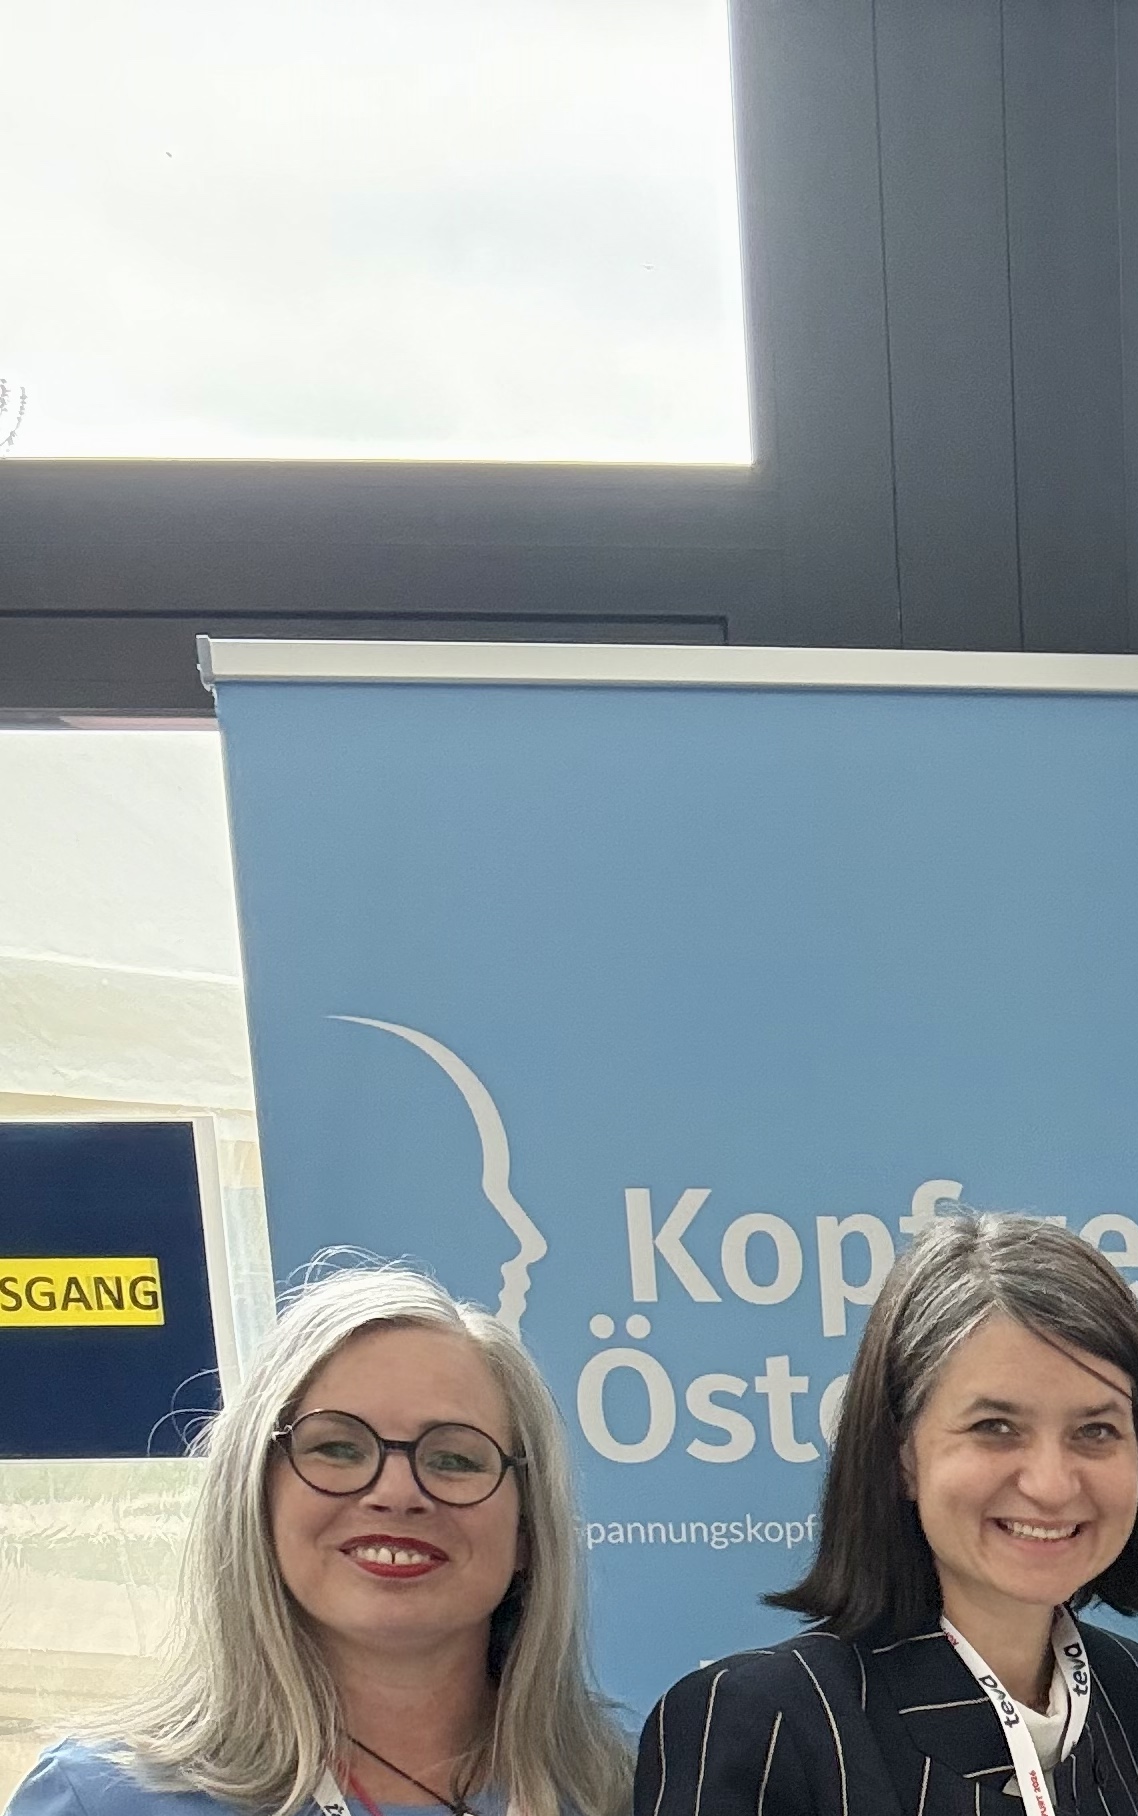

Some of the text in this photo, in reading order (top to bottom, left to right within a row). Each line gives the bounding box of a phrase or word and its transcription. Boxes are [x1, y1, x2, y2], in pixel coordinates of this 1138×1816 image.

[0, 1276, 159, 1311] SGANG
[585, 1513, 817, 1550] pannungskopf
[1063, 1642, 1089, 1697] teva
[979, 1674, 1020, 1728] teva
[1028, 1769, 1041, 1793] 2026
